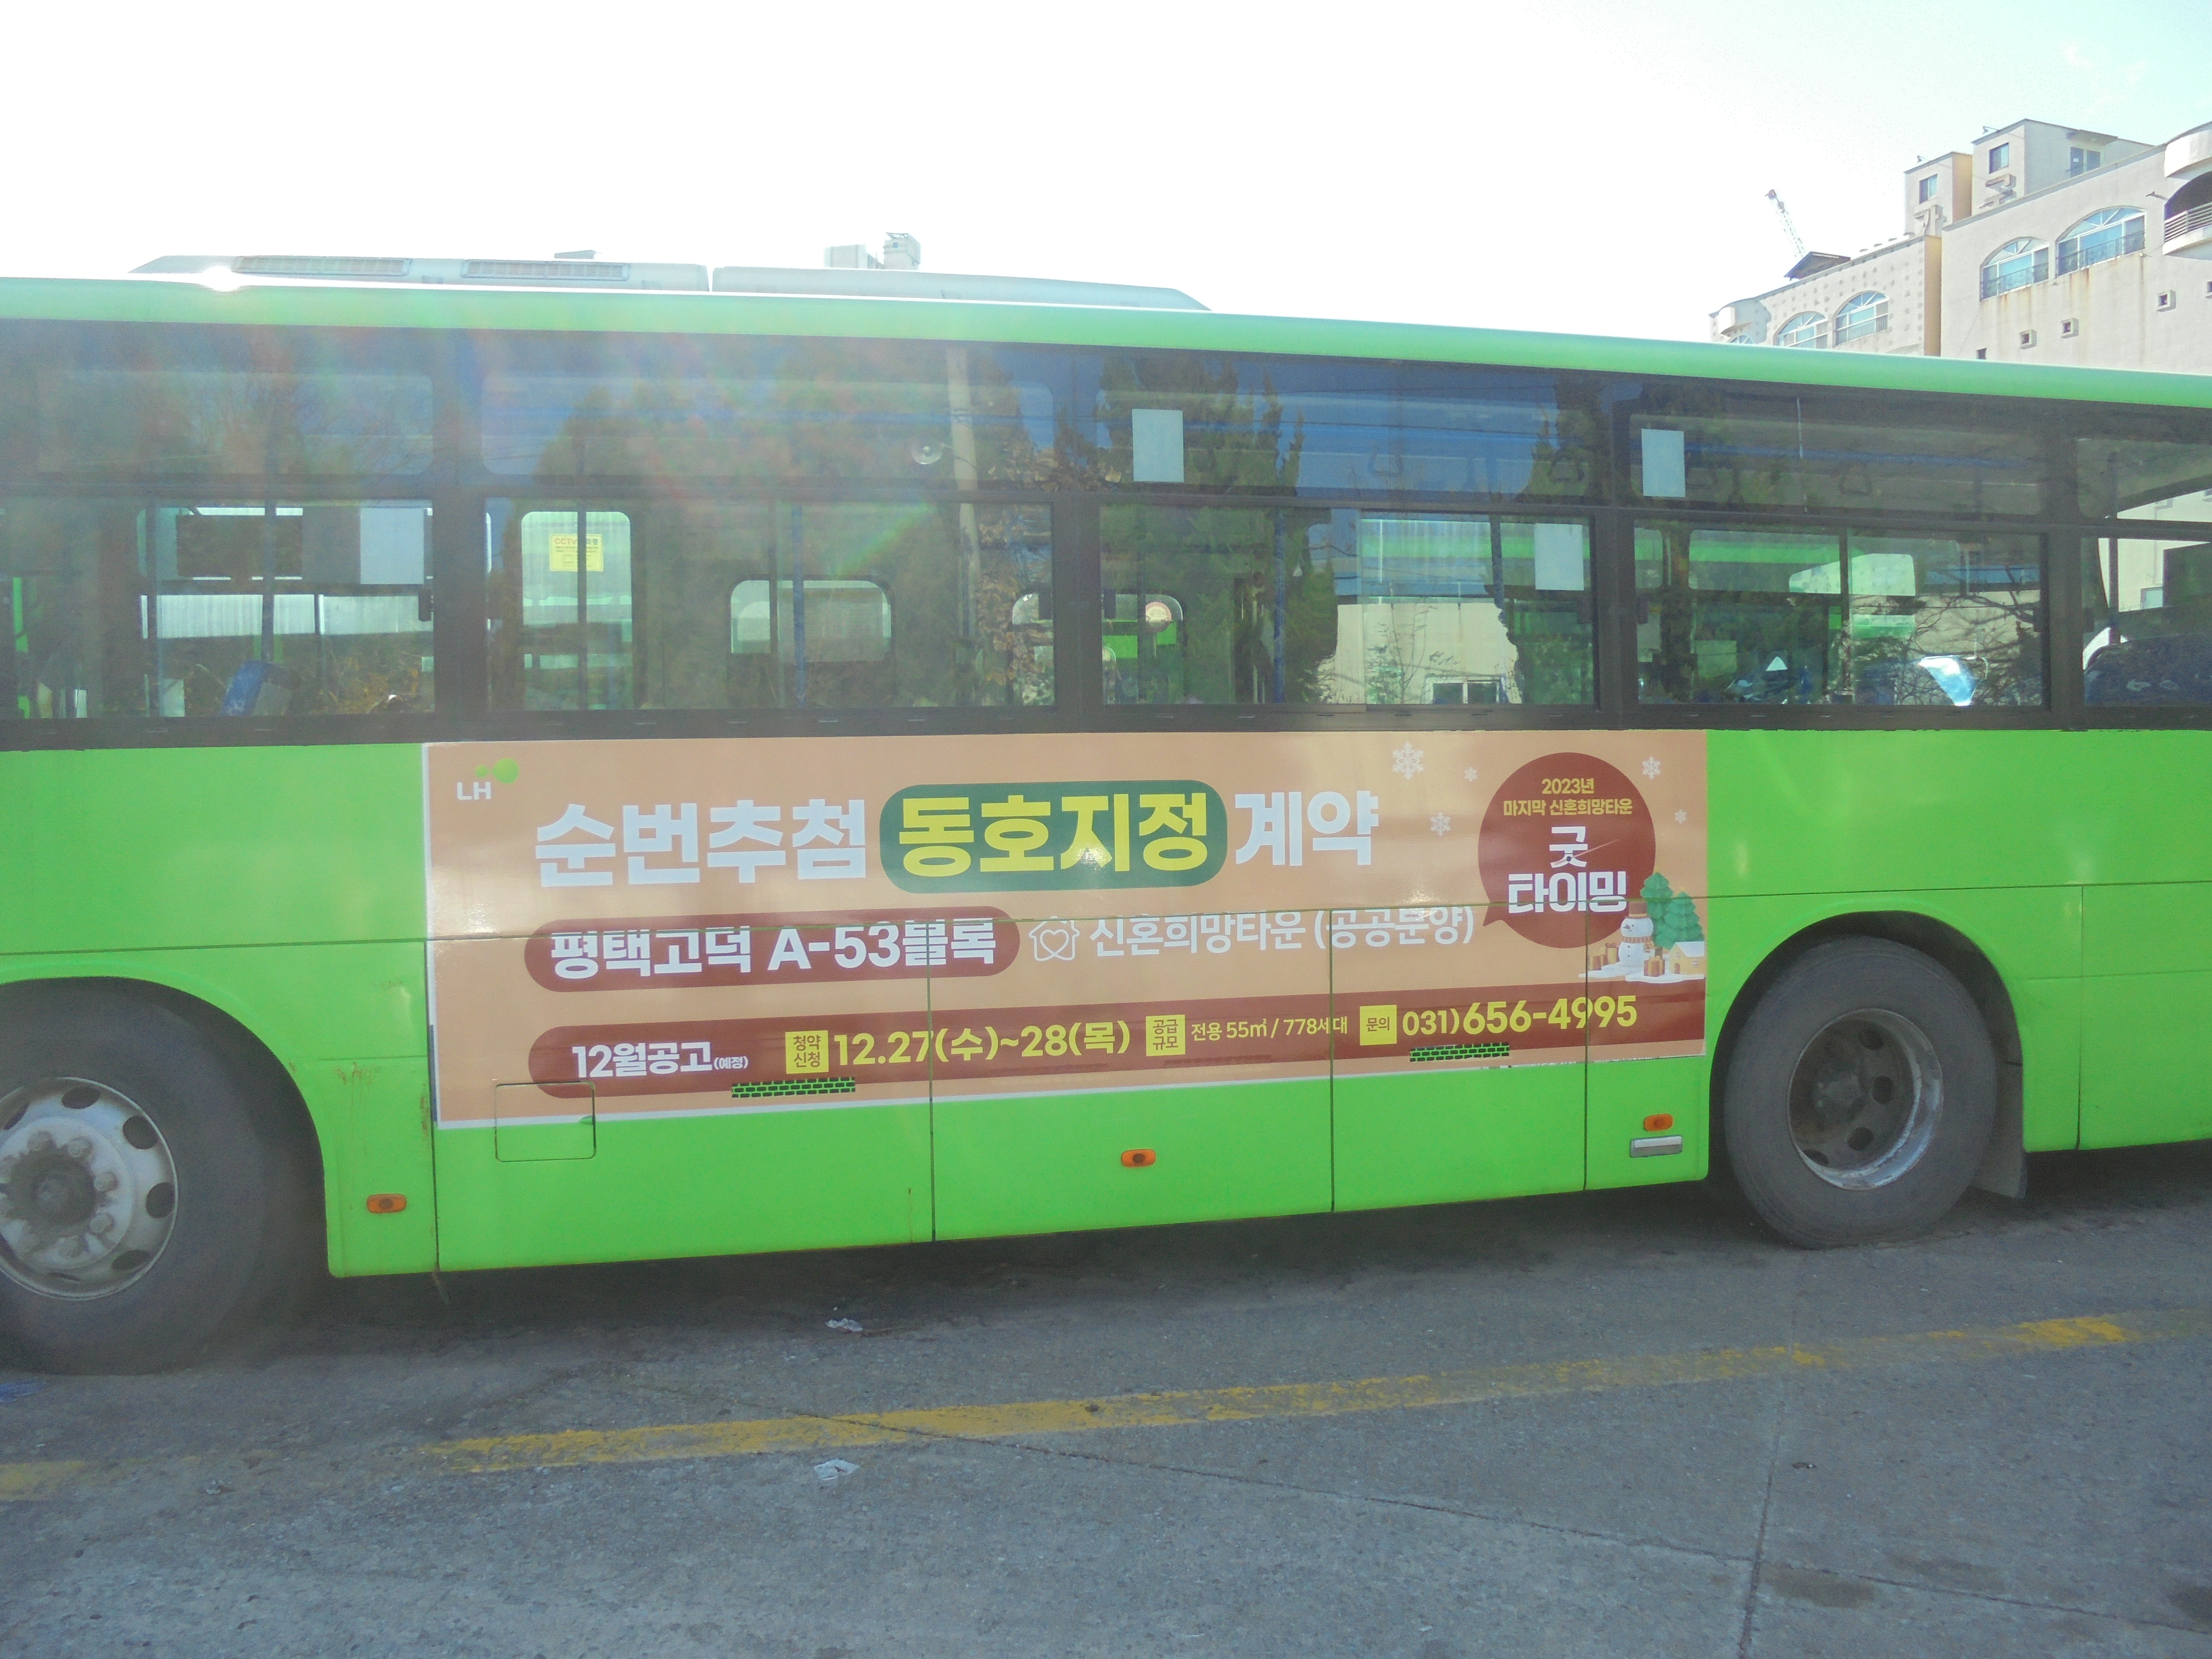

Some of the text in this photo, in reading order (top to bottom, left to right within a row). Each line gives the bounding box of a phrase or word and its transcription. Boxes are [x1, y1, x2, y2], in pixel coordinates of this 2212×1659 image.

[456, 781, 491, 800] LH
[1541, 778, 1595, 794] 2023년
[1504, 798, 1632, 816] 마지막 신혼희망타운
[535, 790, 1379, 887] 순번추첨 동호지정 계약
[1549, 826, 1588, 868] 굿
[1508, 871, 1627, 914] 타이밍
[1090, 906, 1474, 957] 신혼희망타운 (공공분양)
[550, 918, 996, 979] 평택고덕 A-53블록
[1366, 1016, 1390, 1032] 문의
[1402, 995, 1638, 1036] 031)656-4995
[1152, 1019, 1179, 1035] 공급
[1191, 1022, 1222, 1041] 전용
[1283, 1016, 1348, 1036] 778세대
[793, 1034, 821, 1050] 청약
[834, 1020, 1130, 1066] 12.27(수)~28(목)
[1152, 1035, 1179, 1050] 규모
[793, 1051, 821, 1068] 신청
